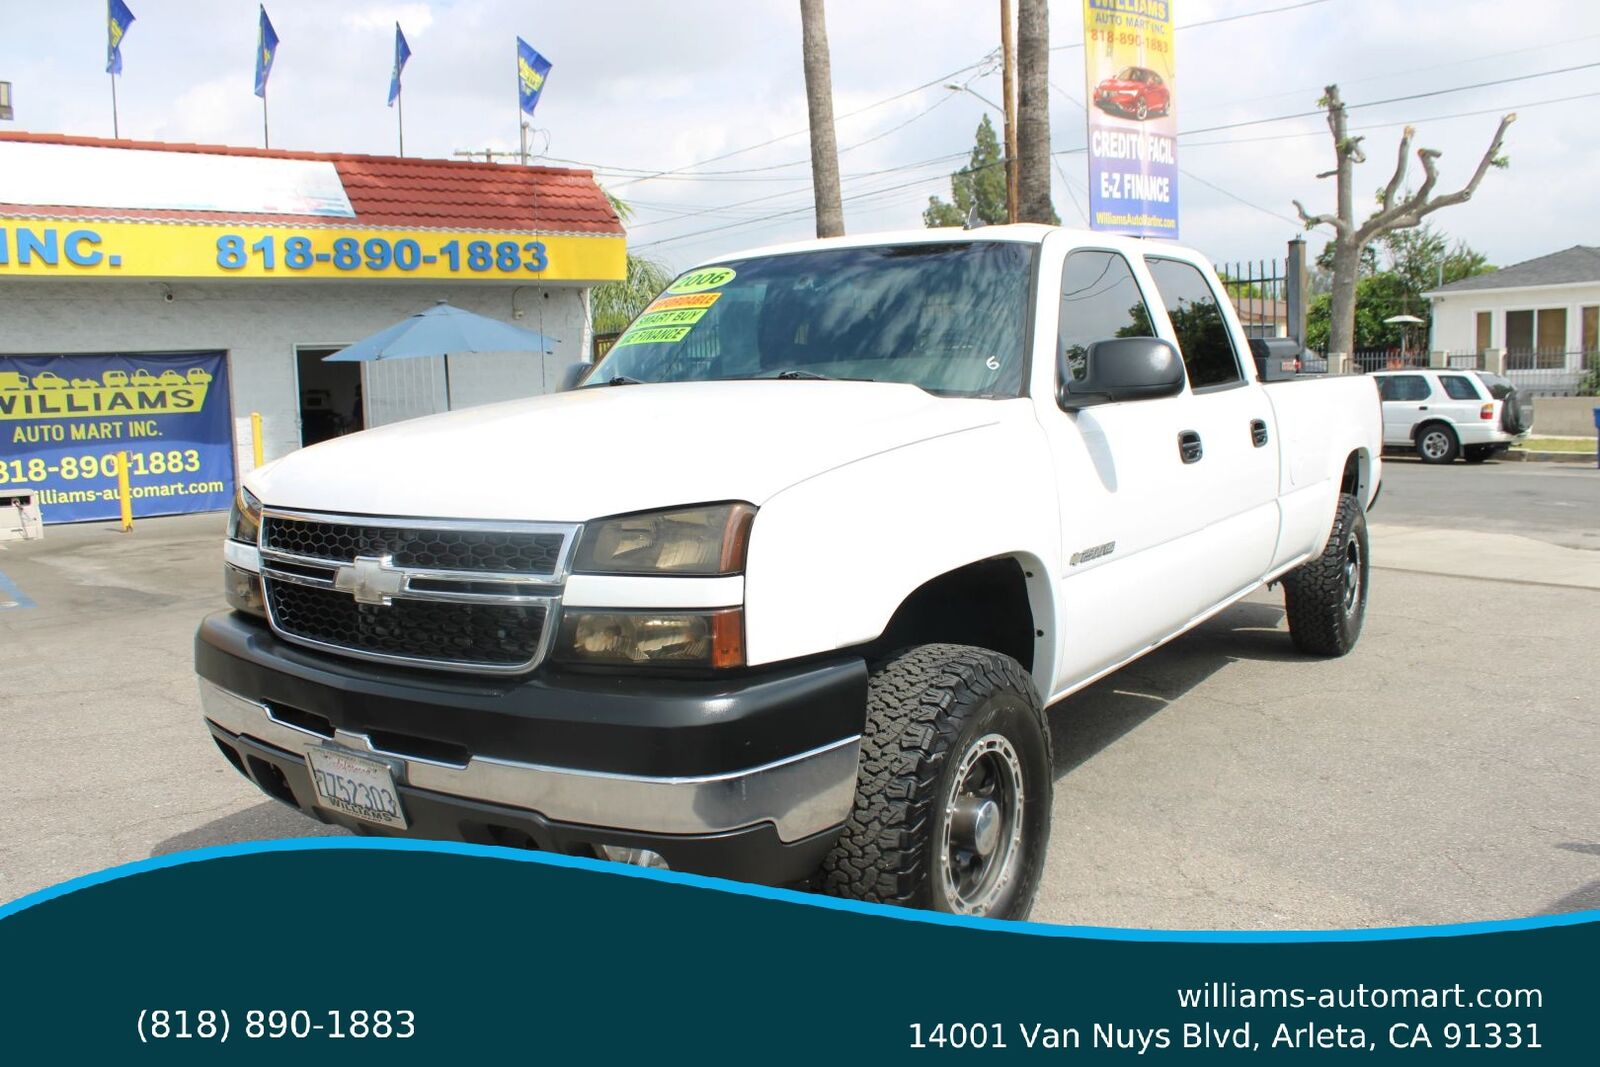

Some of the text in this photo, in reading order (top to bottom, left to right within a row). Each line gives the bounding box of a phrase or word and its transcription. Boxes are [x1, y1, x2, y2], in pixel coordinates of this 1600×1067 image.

[1095, 12, 1122, 26] AUTO
[1126, 17, 1150, 30] MART
[1091, 29, 1169, 53] 818-890-1883
[1101, 172, 1170, 203] E-Z FINANCE
[216, 235, 550, 273] 818-890-1883
[671, 271, 731, 290] 2006
[672, 310, 702, 321] BUY
[637, 328, 687, 341] FINANCE
[985, 355, 1001, 370] 6
[13, 419, 163, 443] AUTO MART INC.
[0, 449, 200, 484] 818-8901883
[328, 796, 393, 822] WILLIAMS
